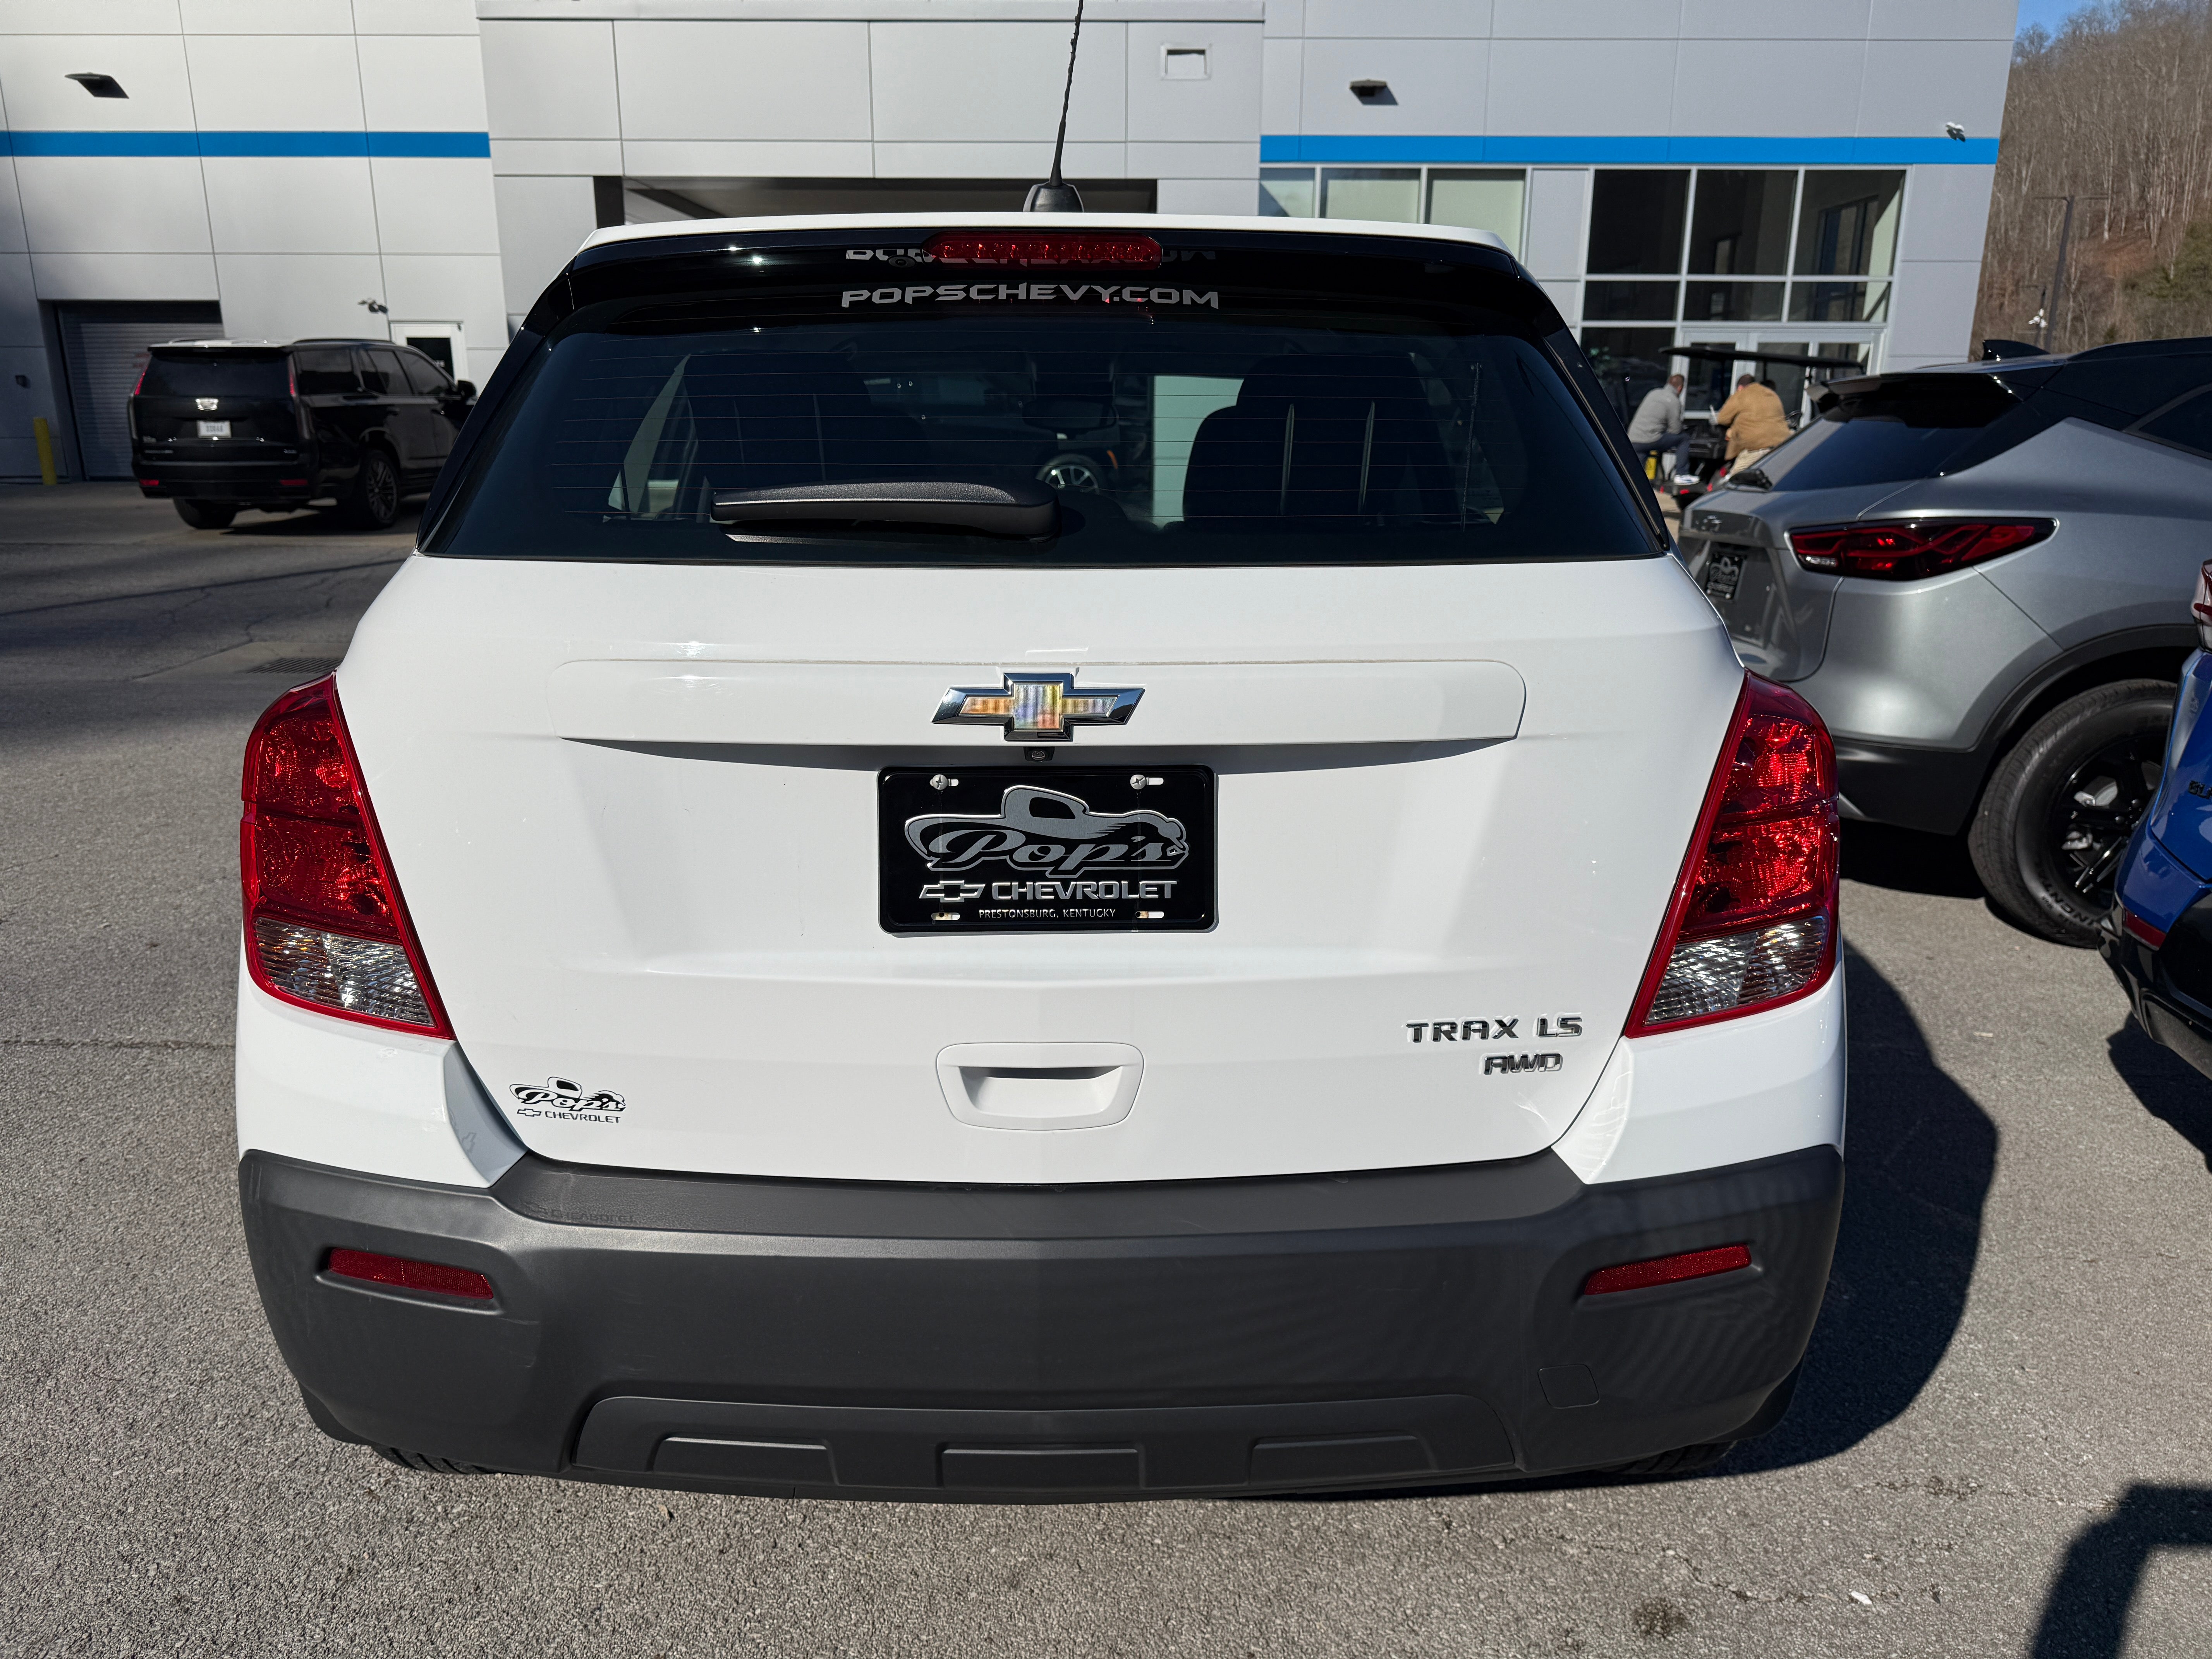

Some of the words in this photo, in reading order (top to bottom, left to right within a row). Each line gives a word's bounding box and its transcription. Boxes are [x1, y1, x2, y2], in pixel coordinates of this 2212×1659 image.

[842, 282, 1219, 309] POPSCHEVY.COM
[928, 829, 1172, 871] Pop's
[992, 880, 1178, 900] CHEVROLET
[979, 908, 1060, 919] PRESTONSBURG,
[1063, 908, 1116, 918] KENTUCKY
[1405, 1017, 1519, 1043] TRAX
[1537, 1016, 1583, 1038] LS
[1484, 1053, 1563, 1075] AWD
[545, 1111, 621, 1123] CHEVROLET
